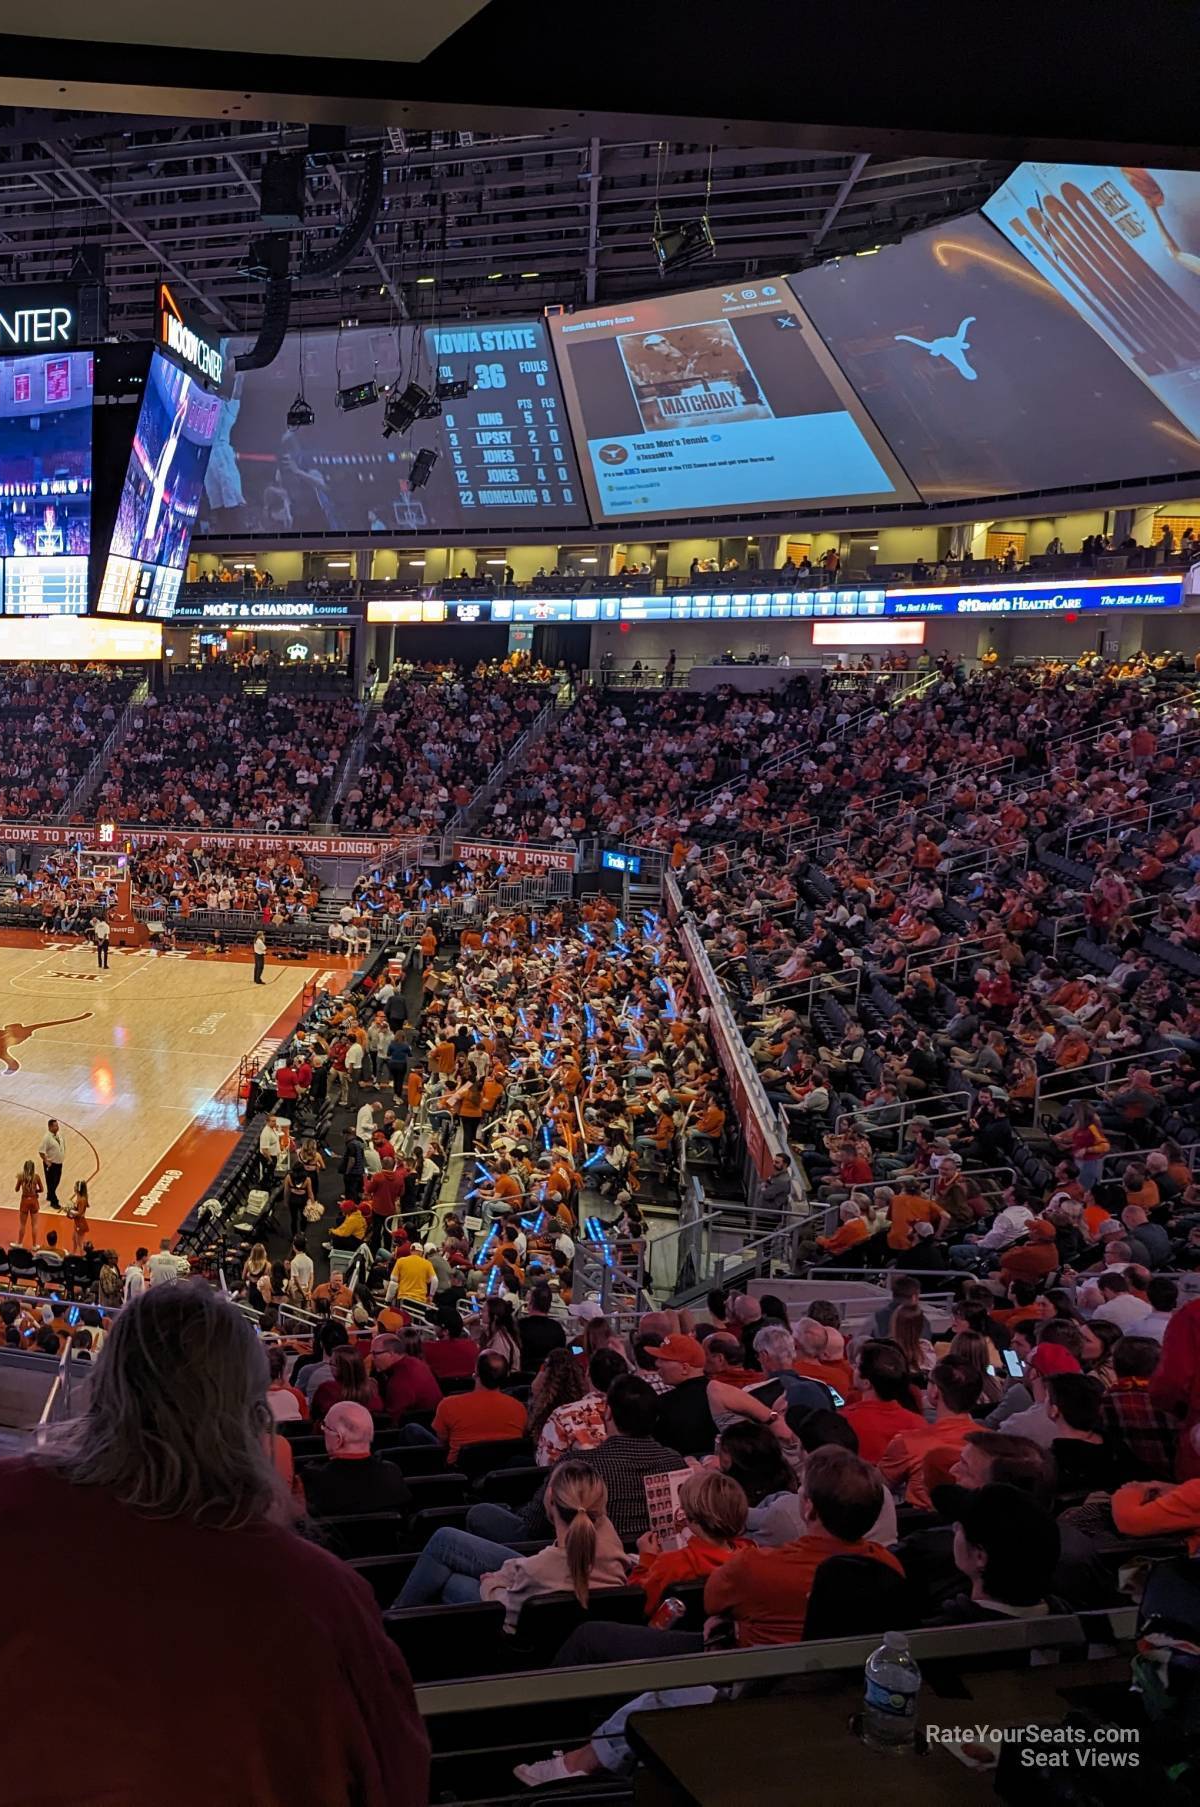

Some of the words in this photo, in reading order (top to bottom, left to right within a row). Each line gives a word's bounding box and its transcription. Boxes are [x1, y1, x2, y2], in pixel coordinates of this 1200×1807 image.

[168, 314, 199, 365] MOODY
[198, 340, 221, 383] CENTER
[434, 332, 481, 354] IOWA
[482, 329, 536, 351] STATE
[519, 361, 548, 374] FOULS
[475, 364, 507, 389] 36
[536, 374, 545, 386] 0
[517, 399, 533, 410] PTS
[541, 397, 555, 408] FLS
[662, 390, 738, 416] MATCHDAY
[446, 414, 455, 428] 0
[477, 413, 503, 426] KING
[524, 411, 533, 424] 5
[546, 410, 554, 423] 1
[450, 433, 458, 446] 3
[476, 431, 512, 445] LIPSEY
[528, 430, 537, 443] 2
[550, 430, 559, 442] 0
[632, 440, 655, 450] Texas
[656, 438, 681, 448] Men's
[681, 436, 709, 445] Tennis
[453, 451, 462, 464] 5
[483, 450, 515, 463] JONES
[532, 450, 540, 462] 7
[554, 448, 563, 461] 0
[455, 470, 469, 483] 12
[488, 469, 519, 483] JONES
[537, 469, 546, 481] 4
[559, 468, 568, 481] 0
[460, 491, 474, 505] 22
[542, 489, 551, 502] 8
[564, 489, 573, 502] 0
[895, 603, 906, 612] The
[907, 603, 920, 612] Best
[1101, 596, 1116, 605] The
[1116, 596, 1134, 604] Best
[1143, 595, 1165, 604] Here.
[173, 607, 202, 615] PÉRIAL
[203, 601, 239, 616] MOËT
[239, 603, 249, 616] &
[250, 603, 314, 616] CHANDON
[1105, 641, 1119, 651] 116
[44, 830, 59, 842] TO
[201, 837, 235, 849] HOME
[239, 838, 252, 850] OF
[257, 838, 282, 850] THE
[286, 839, 327, 852] TEXAS
[460, 846, 492, 859] HOOK
[525, 853, 568, 868] HORNS
[608, 853, 634, 870] inded
[44, 943, 192, 959] TEXAS
